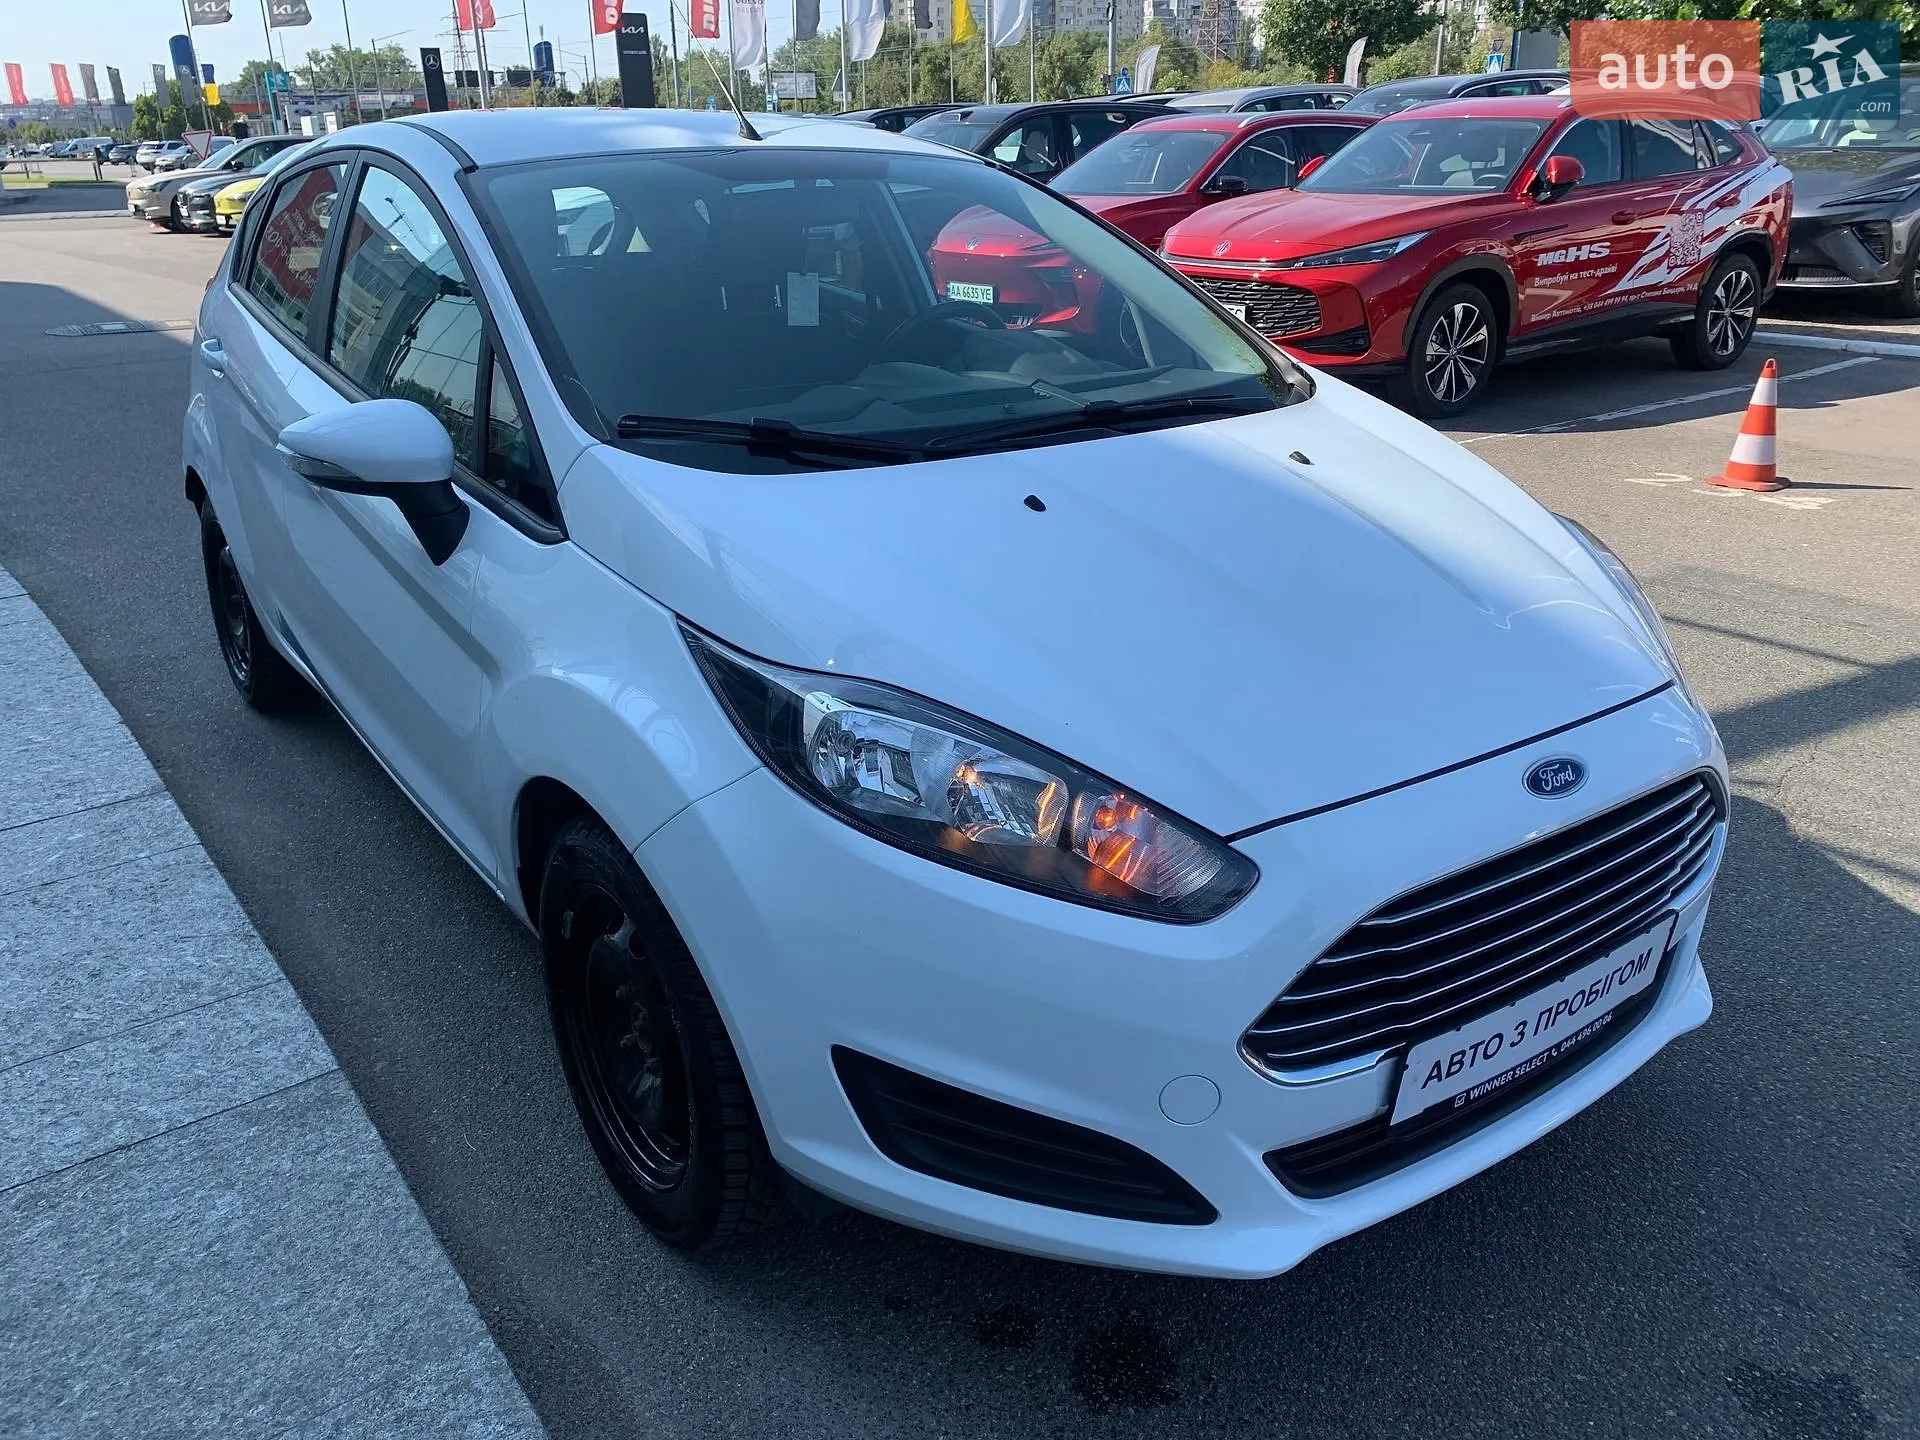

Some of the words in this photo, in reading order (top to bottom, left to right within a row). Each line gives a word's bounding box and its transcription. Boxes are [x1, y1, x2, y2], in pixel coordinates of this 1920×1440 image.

[951, 284, 961, 296] AA
[962, 286, 979, 299] 6635
[980, 288, 991, 301] YE
[1538, 764, 1576, 791] Ford
[1420, 1032, 1504, 1090] АВТО
[1532, 947, 1654, 1038] ПРОБІГОМ
[1469, 1071, 1514, 1100] WINNER
[1514, 1051, 1550, 1078] SELECT
